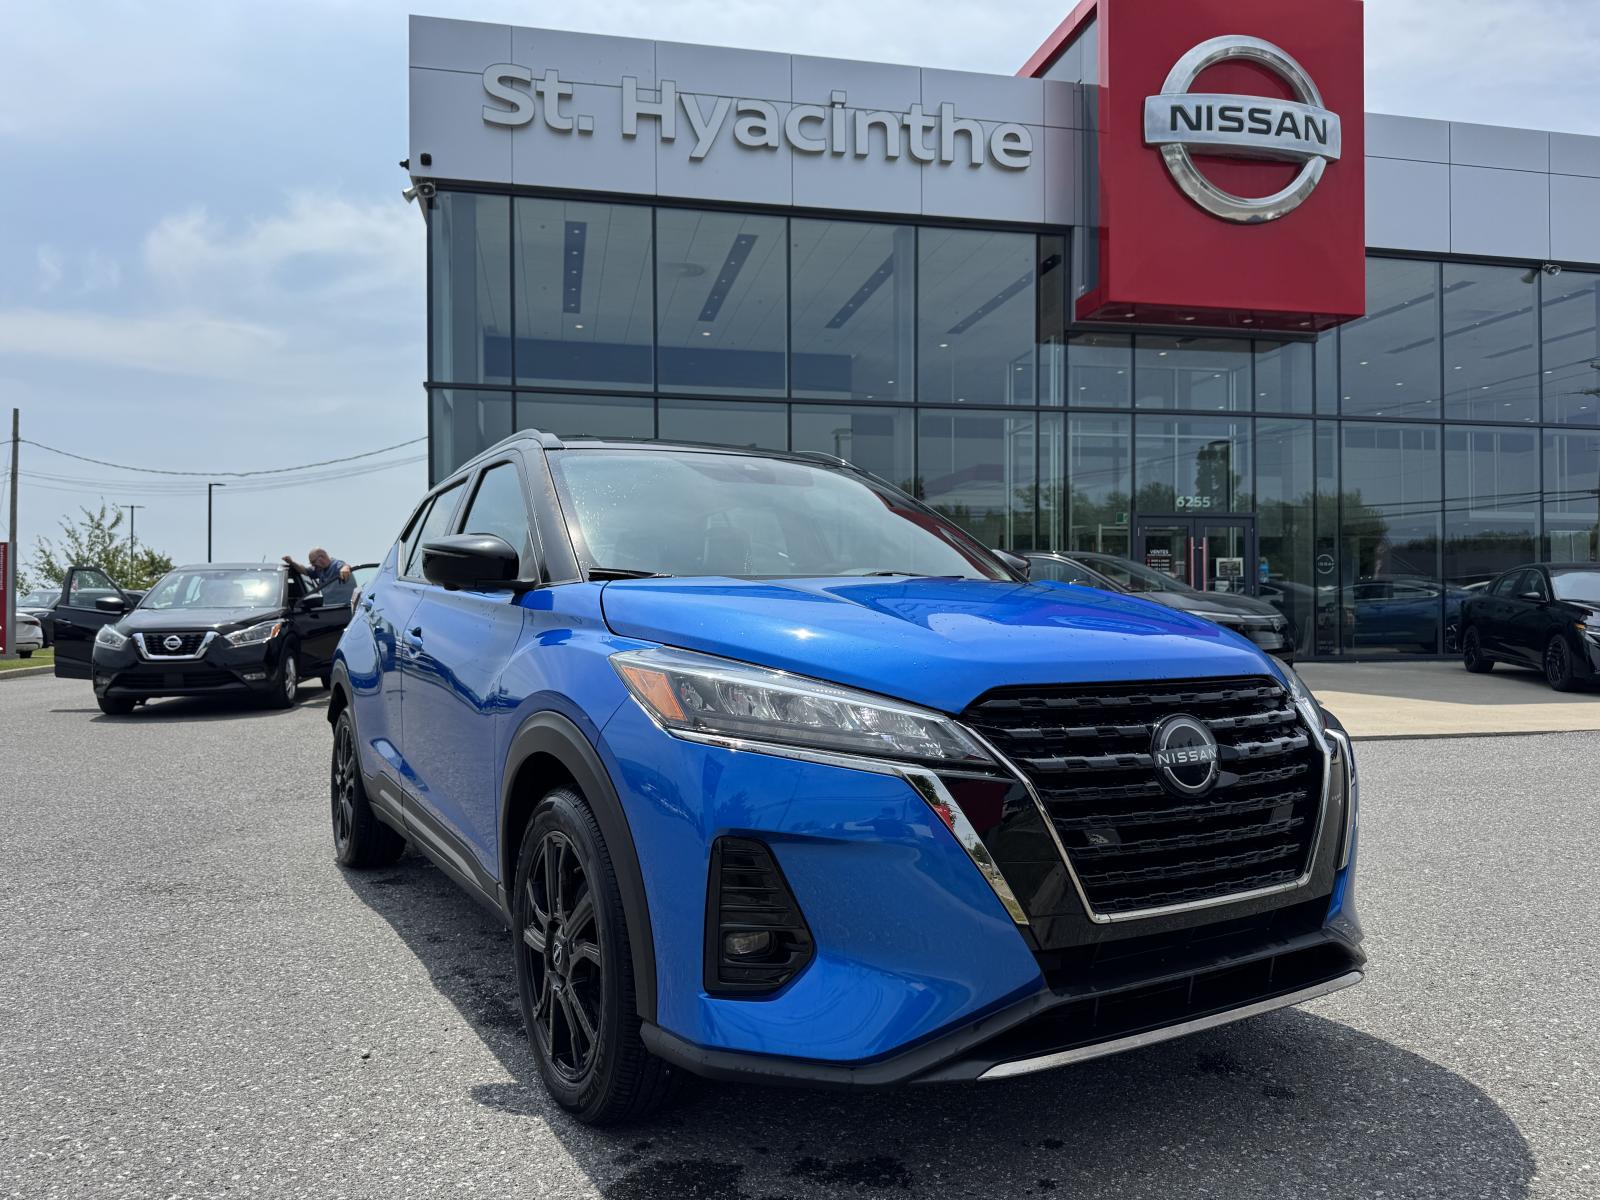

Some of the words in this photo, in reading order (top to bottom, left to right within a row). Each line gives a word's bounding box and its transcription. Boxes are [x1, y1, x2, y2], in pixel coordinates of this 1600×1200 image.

[482, 63, 594, 134] St.
[621, 75, 1034, 170] Hyacinthe
[1169, 104, 1328, 145] NISSAN
[1176, 496, 1211, 508] 6255
[1158, 747, 1217, 765] NISSAN
